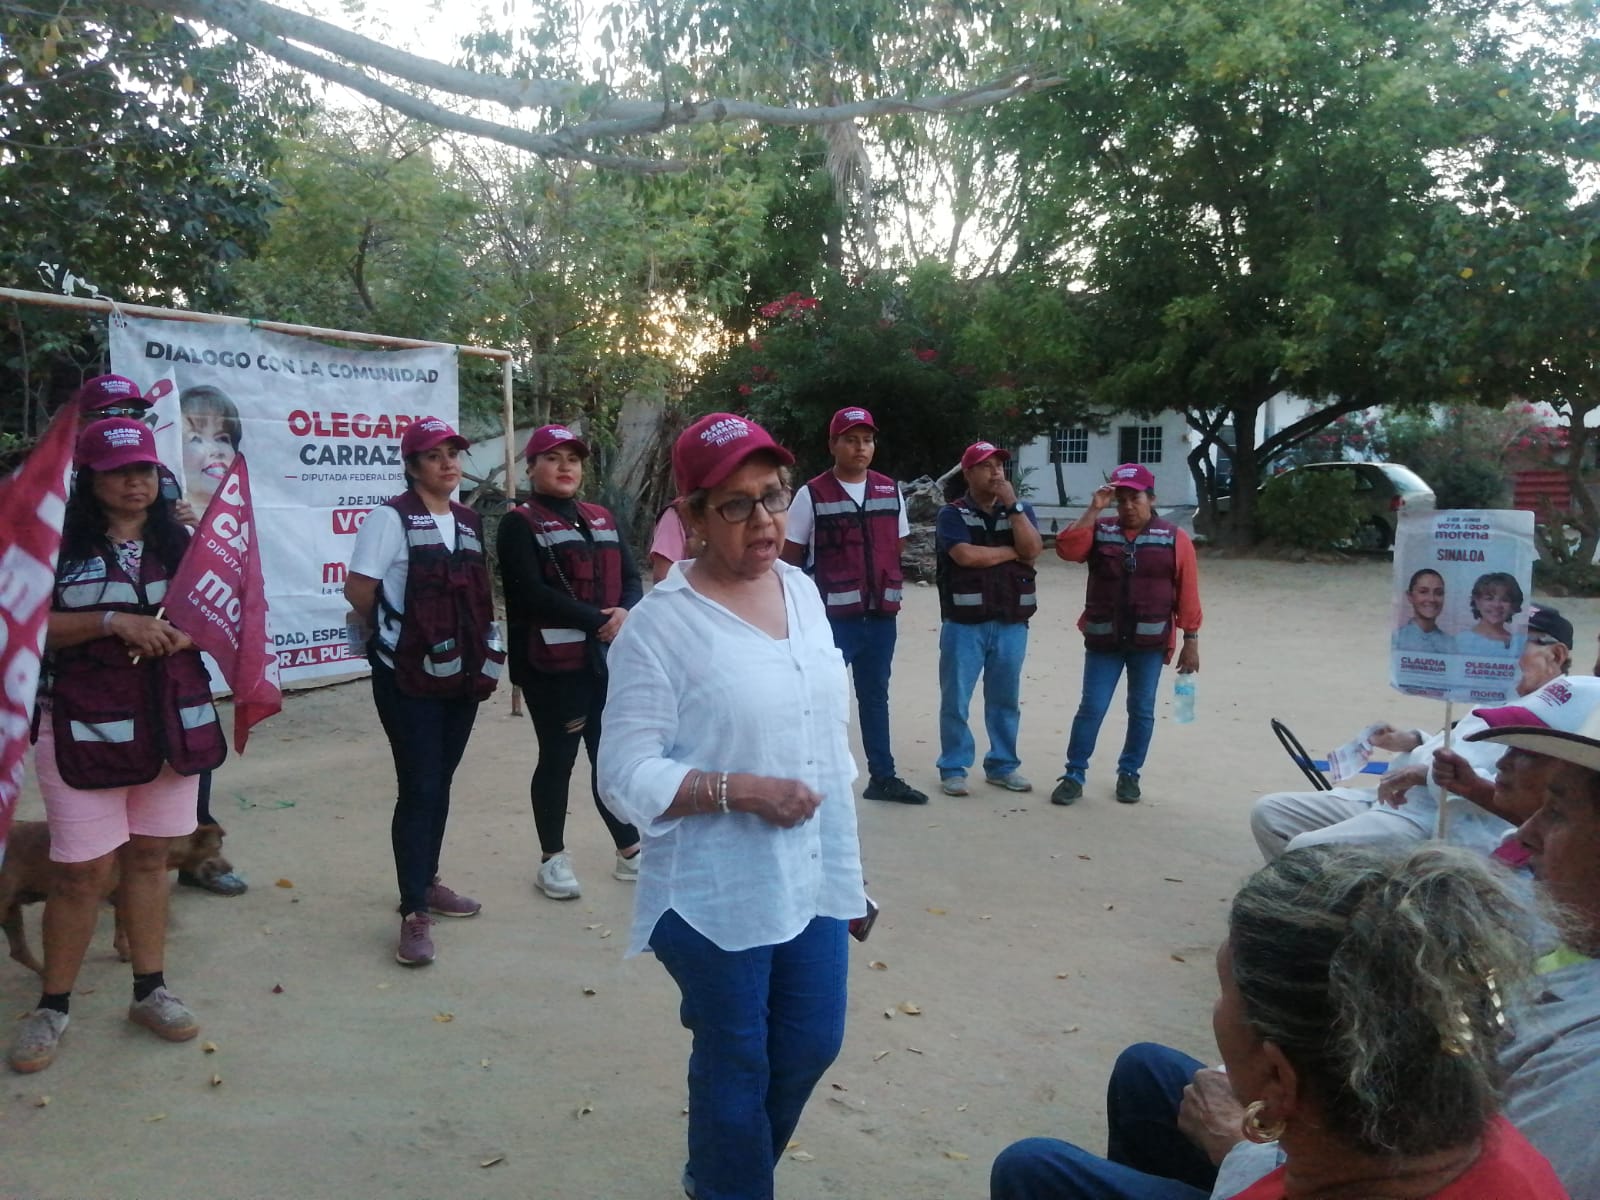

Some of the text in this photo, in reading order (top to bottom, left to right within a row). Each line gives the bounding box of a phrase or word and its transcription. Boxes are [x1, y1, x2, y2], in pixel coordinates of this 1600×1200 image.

[146, 341, 439, 384] DIALOGO CON LA COMUNIDAD
[288, 410, 433, 439] OLEGAR
[302, 473, 347, 482] DIPUTADA
[350, 473, 387, 481] FEDERAL
[338, 497, 345, 506] 2
[348, 496, 364, 506] DE
[1435, 530, 1489, 540] morena
[1436, 548, 1486, 562] SINALOA
[187, 591, 200, 606] La
[273, 631, 309, 646] DAD,
[296, 649, 318, 666] AL
[1400, 656, 1446, 667] CLAUDIA
[1465, 661, 1515, 670] OLEGARIA
